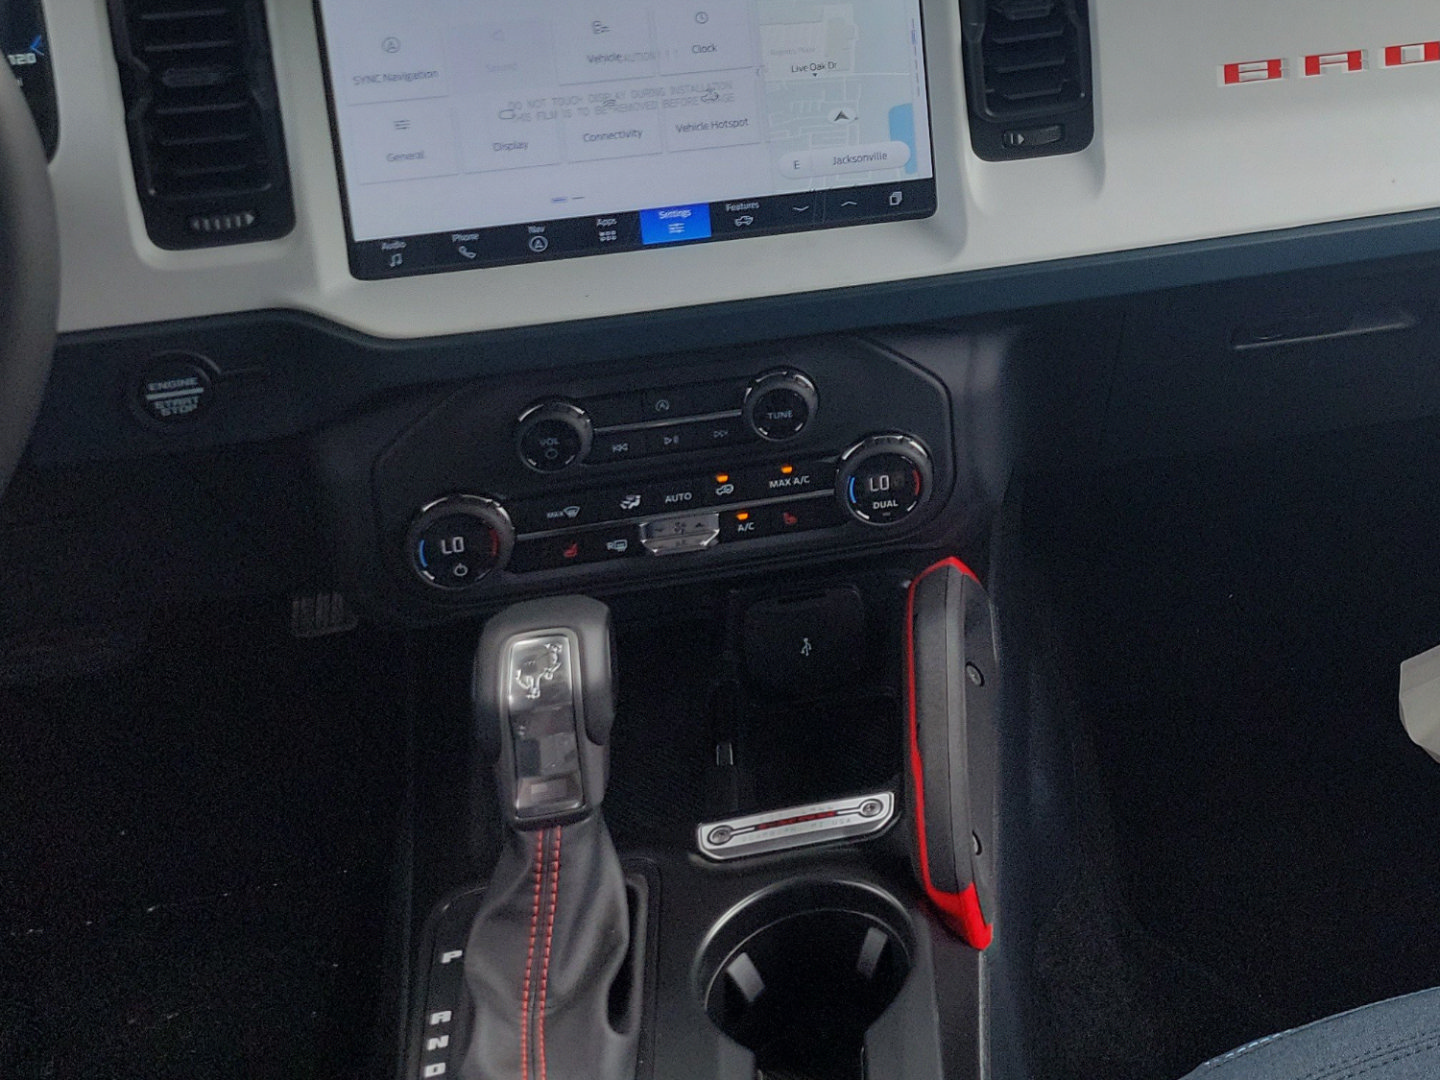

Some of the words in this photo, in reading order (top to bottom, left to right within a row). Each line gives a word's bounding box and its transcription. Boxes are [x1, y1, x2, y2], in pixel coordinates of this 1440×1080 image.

[691, 43, 718, 54] Clock
[587, 52, 621, 64] Vehicle
[791, 65, 808, 73] Live
[809, 62, 825, 71] Oak
[827, 61, 838, 69] Dr
[674, 123, 709, 133] Vehicle
[711, 118, 750, 131] Hotspot
[583, 129, 643, 143] Connectivity
[492, 141, 528, 152] Display
[386, 151, 424, 162] General
[833, 151, 888, 166] Jacksonville
[793, 160, 801, 169] E
[726, 200, 760, 212] Features
[658, 208, 692, 220] Settings
[596, 218, 617, 228] Apps
[527, 225, 545, 234] Nav
[452, 233, 479, 243] Phone
[148, 377, 199, 391] ENGINE
[767, 410, 794, 419] TUNE
[769, 477, 791, 488] MAX
[793, 475, 811, 485] A/C
[869, 474, 890, 493] LO
[665, 491, 693, 504] AUTO
[872, 499, 899, 510] DUAL
[737, 522, 755, 532] A/C
[441, 536, 465, 555] LO
[441, 949, 463, 964] P
[429, 1010, 452, 1026] R
[426, 1034, 450, 1051] N
[423, 1062, 447, 1078] D
